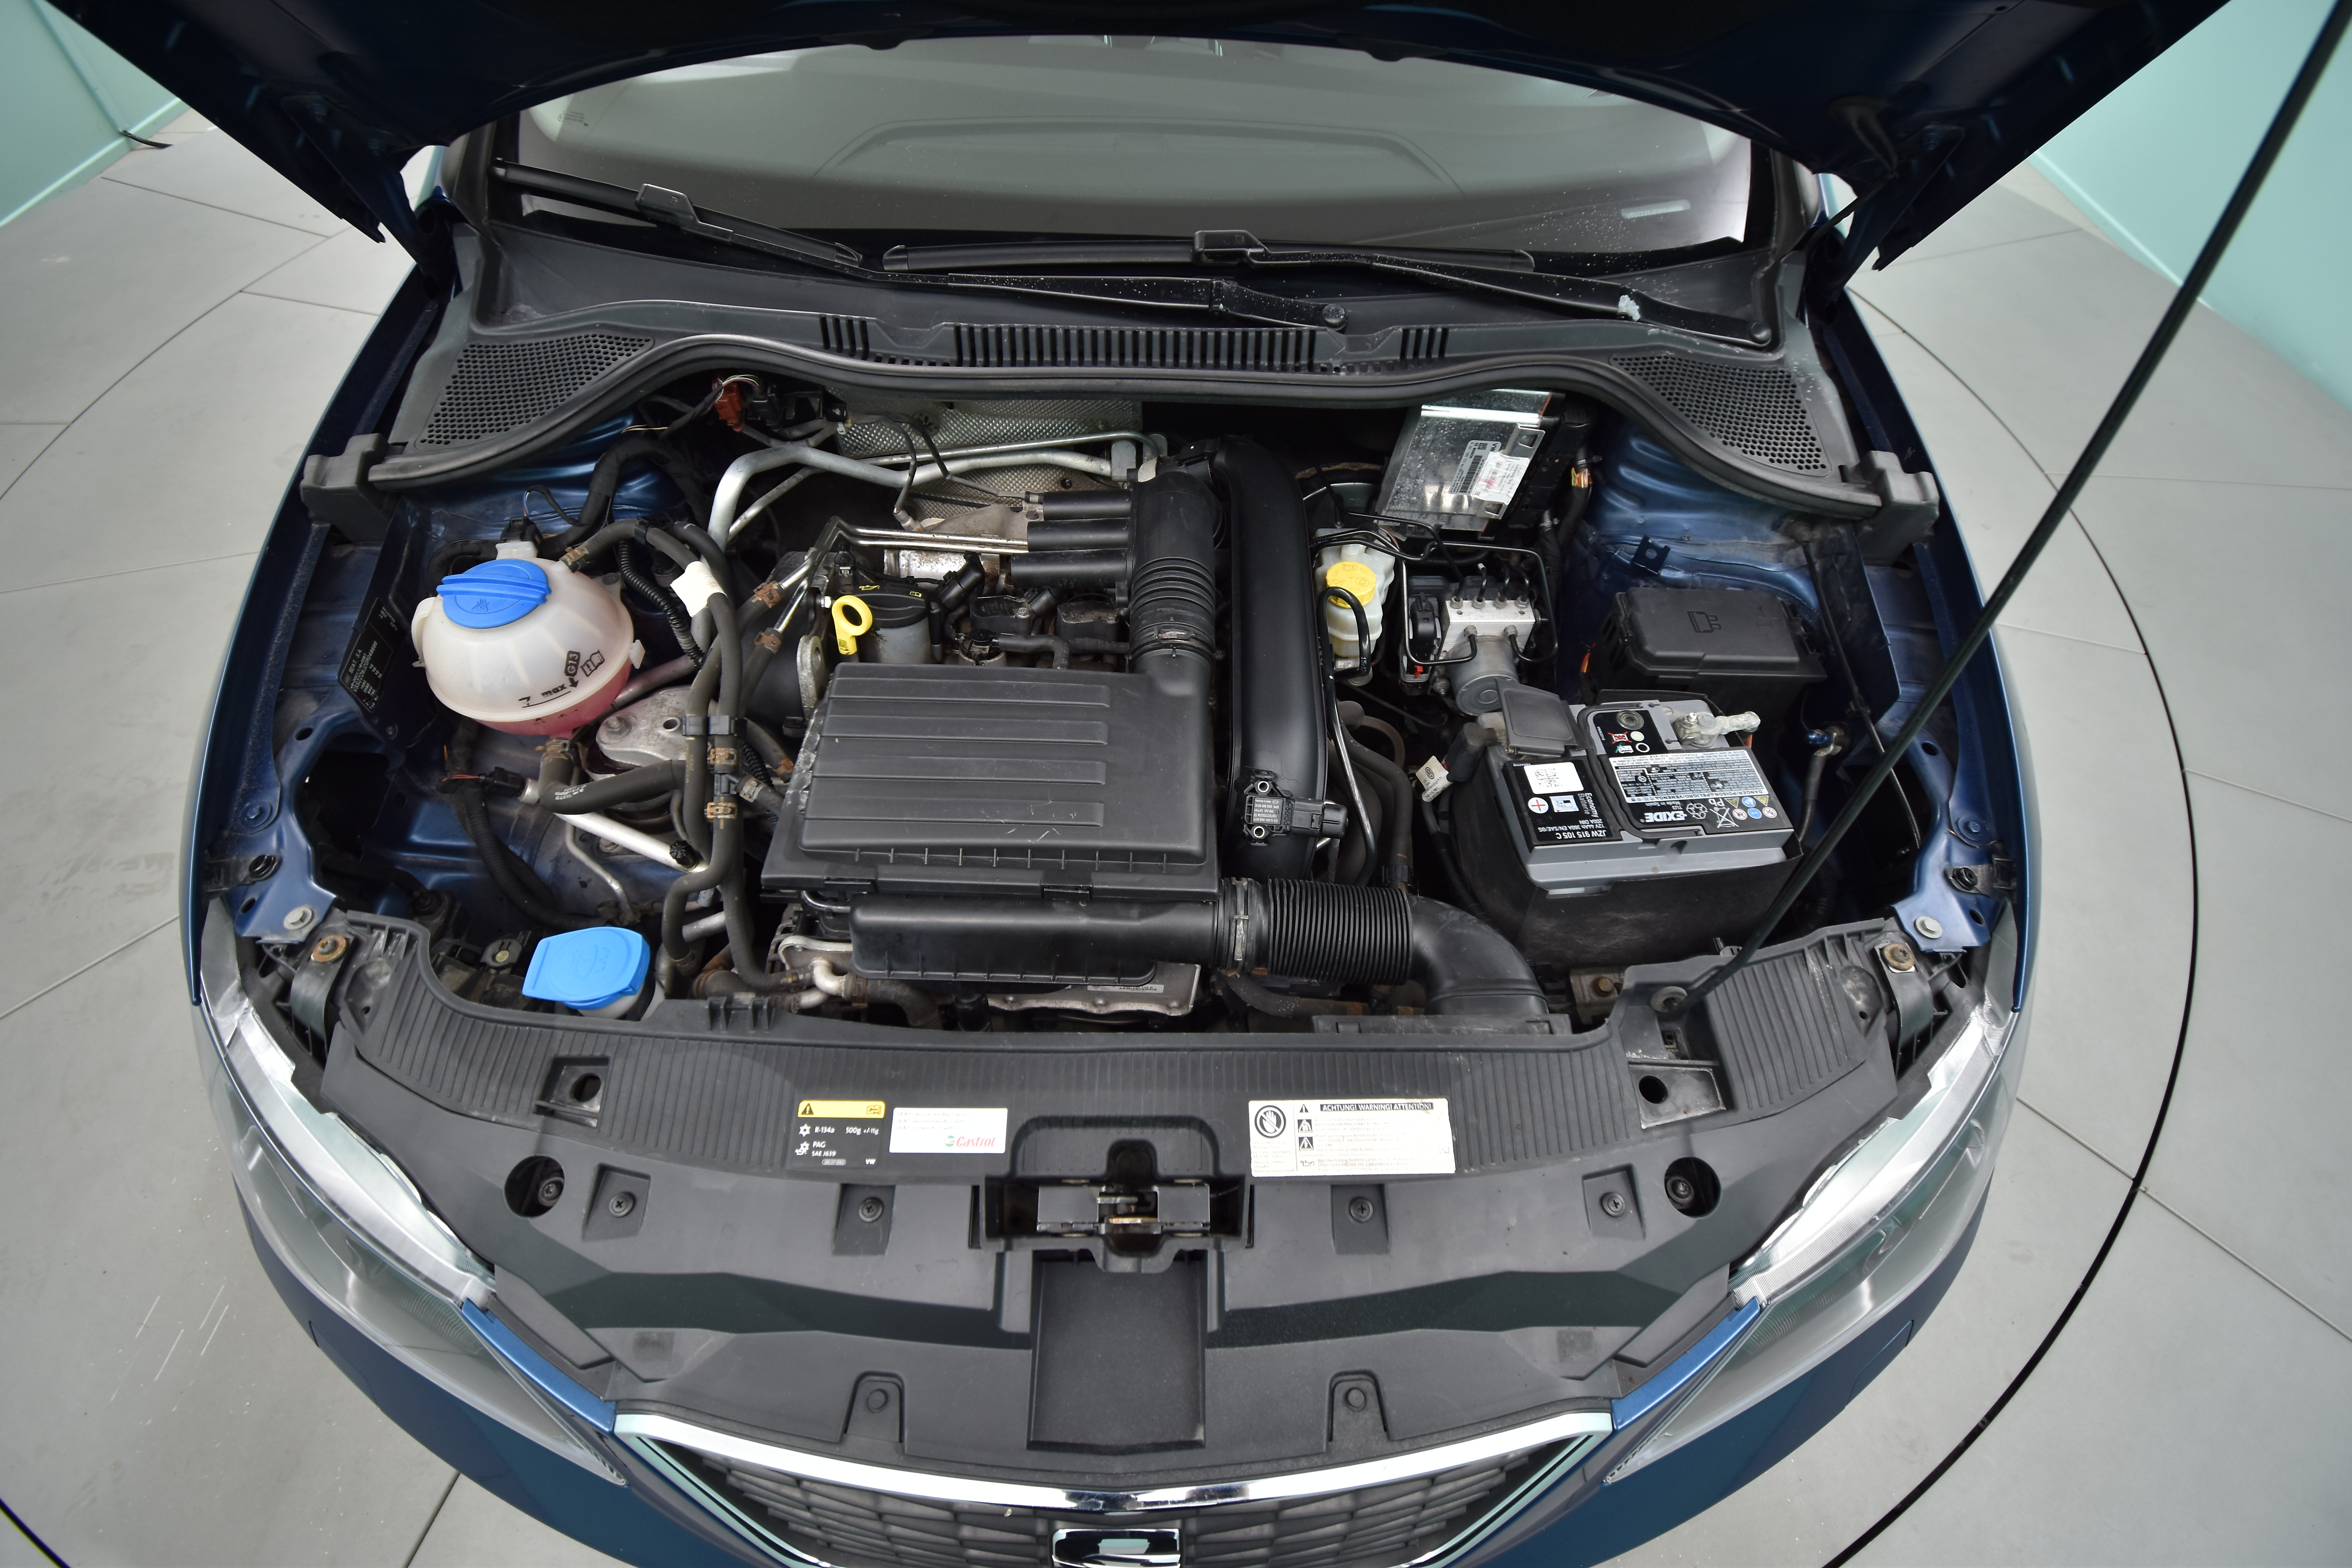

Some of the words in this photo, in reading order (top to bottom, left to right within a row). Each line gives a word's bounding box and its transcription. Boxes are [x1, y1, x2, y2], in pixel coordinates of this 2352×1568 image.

[1490, 443, 1498, 452] VW
[567, 653, 578, 673] G13
[541, 684, 567, 697] max
[1577, 793, 1590, 814] Batterie
[1585, 793, 1599, 817] Economy
[1708, 798, 1725, 806] Pb
[1644, 811, 1686, 822] EXIDE
[846, 1127, 861, 1135] 500g
[956, 1136, 995, 1148] Castrol
